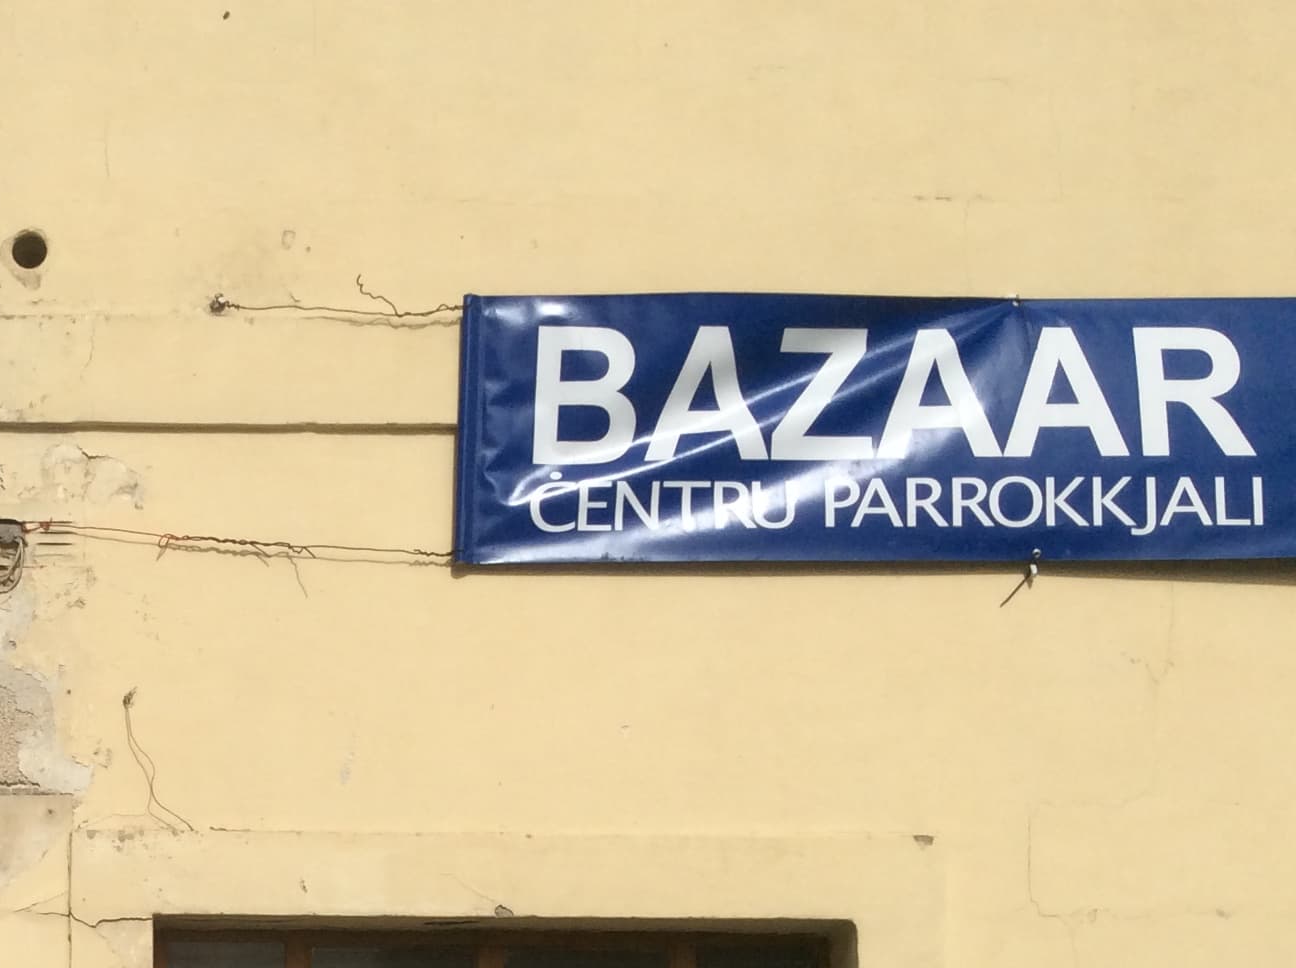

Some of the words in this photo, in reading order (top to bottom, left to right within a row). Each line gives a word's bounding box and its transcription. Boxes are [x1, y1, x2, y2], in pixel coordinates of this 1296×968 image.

[532, 325, 1257, 465] BAZAAR
[530, 472, 798, 534] ĊENTRU
[825, 476, 1264, 536] PARROKKJALI
